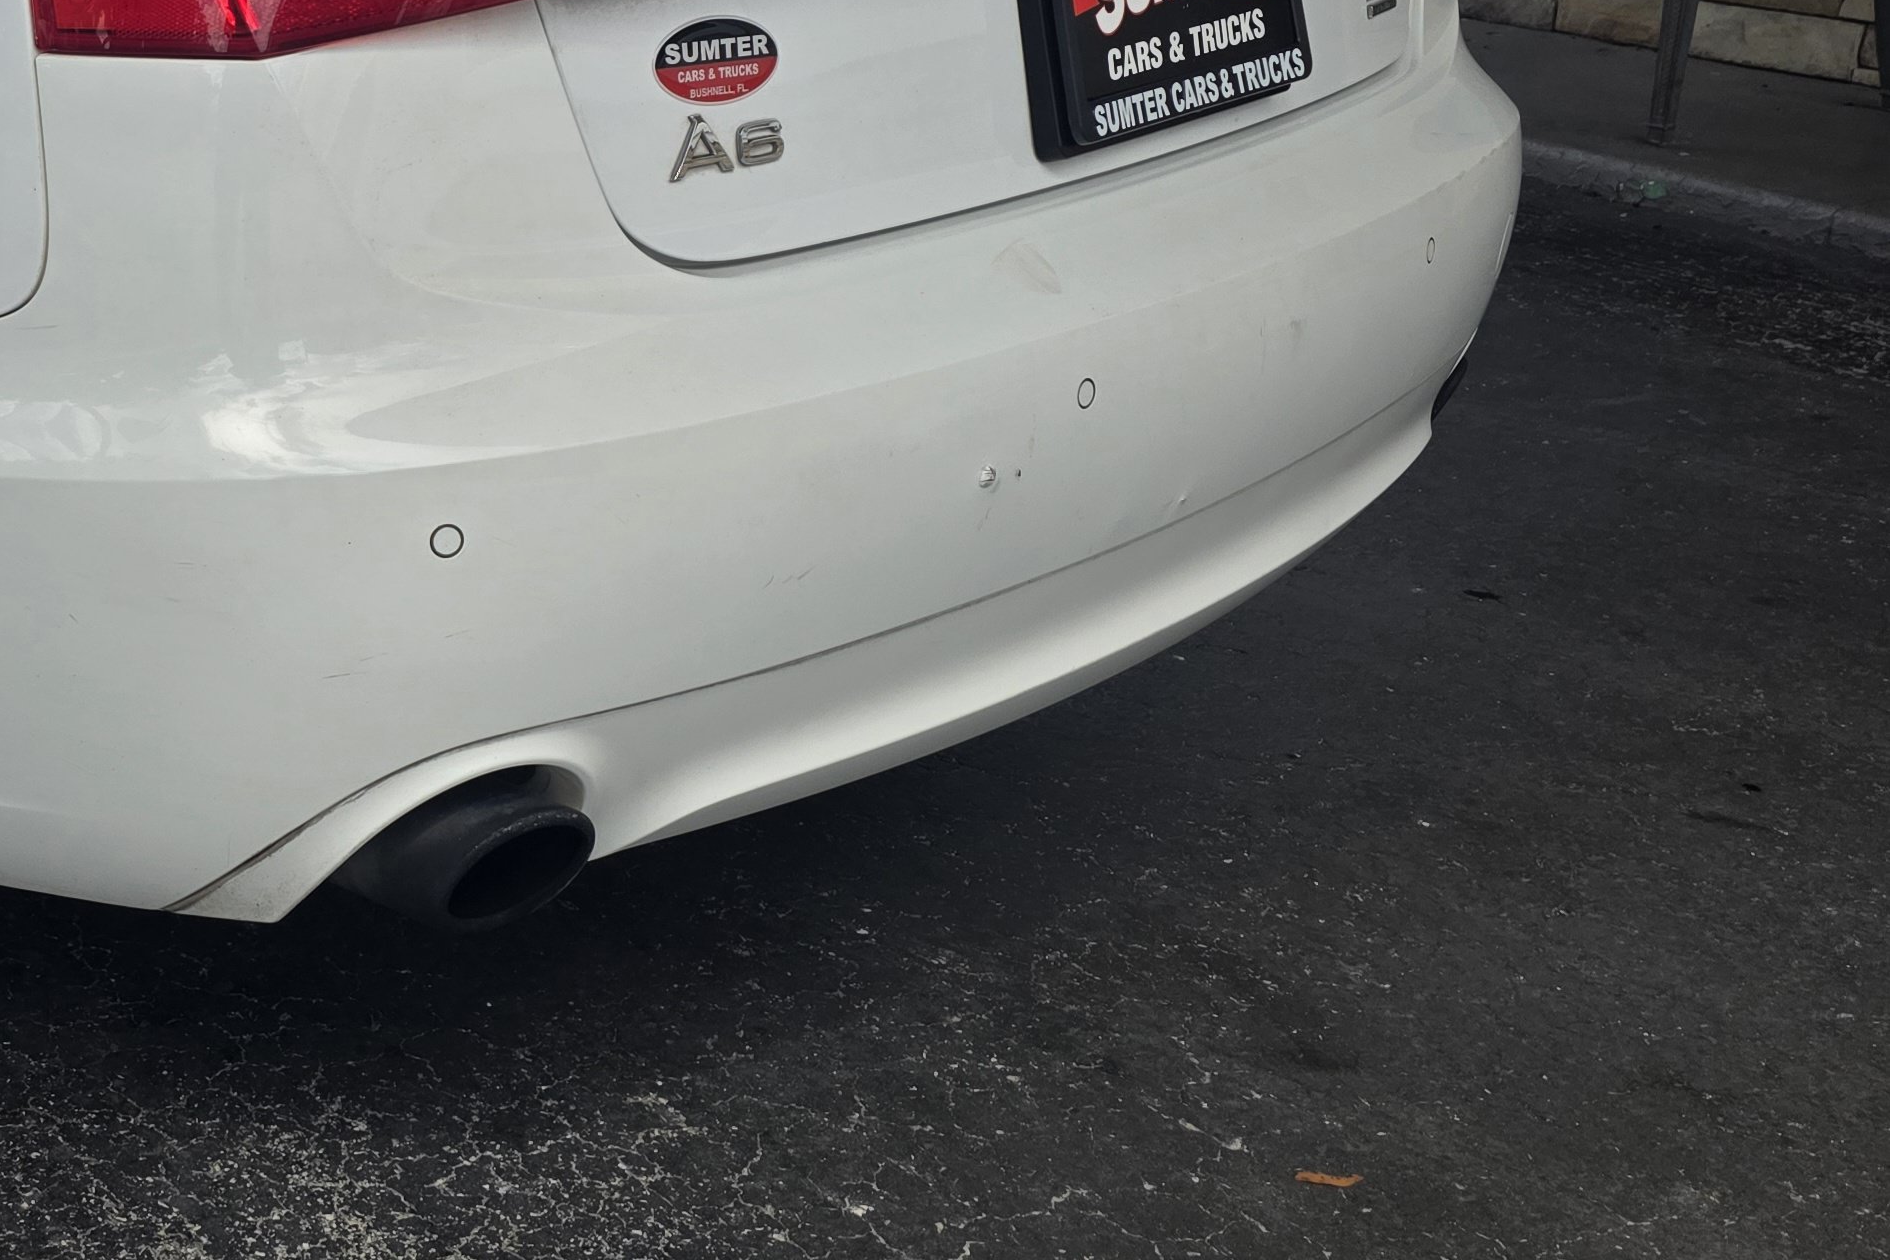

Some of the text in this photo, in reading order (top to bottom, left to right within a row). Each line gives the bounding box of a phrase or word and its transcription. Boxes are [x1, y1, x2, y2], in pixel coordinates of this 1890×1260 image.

[664, 34, 770, 65] SUMTER
[1107, 8, 1266, 81] CARS & TRUCKS
[677, 63, 759, 84] CARS & TRUCKS
[690, 83, 750, 99] BUSHNELL, FL
[1094, 48, 1305, 137] SUMTER CARS & TRUCKS
[668, 113, 785, 183] A6
